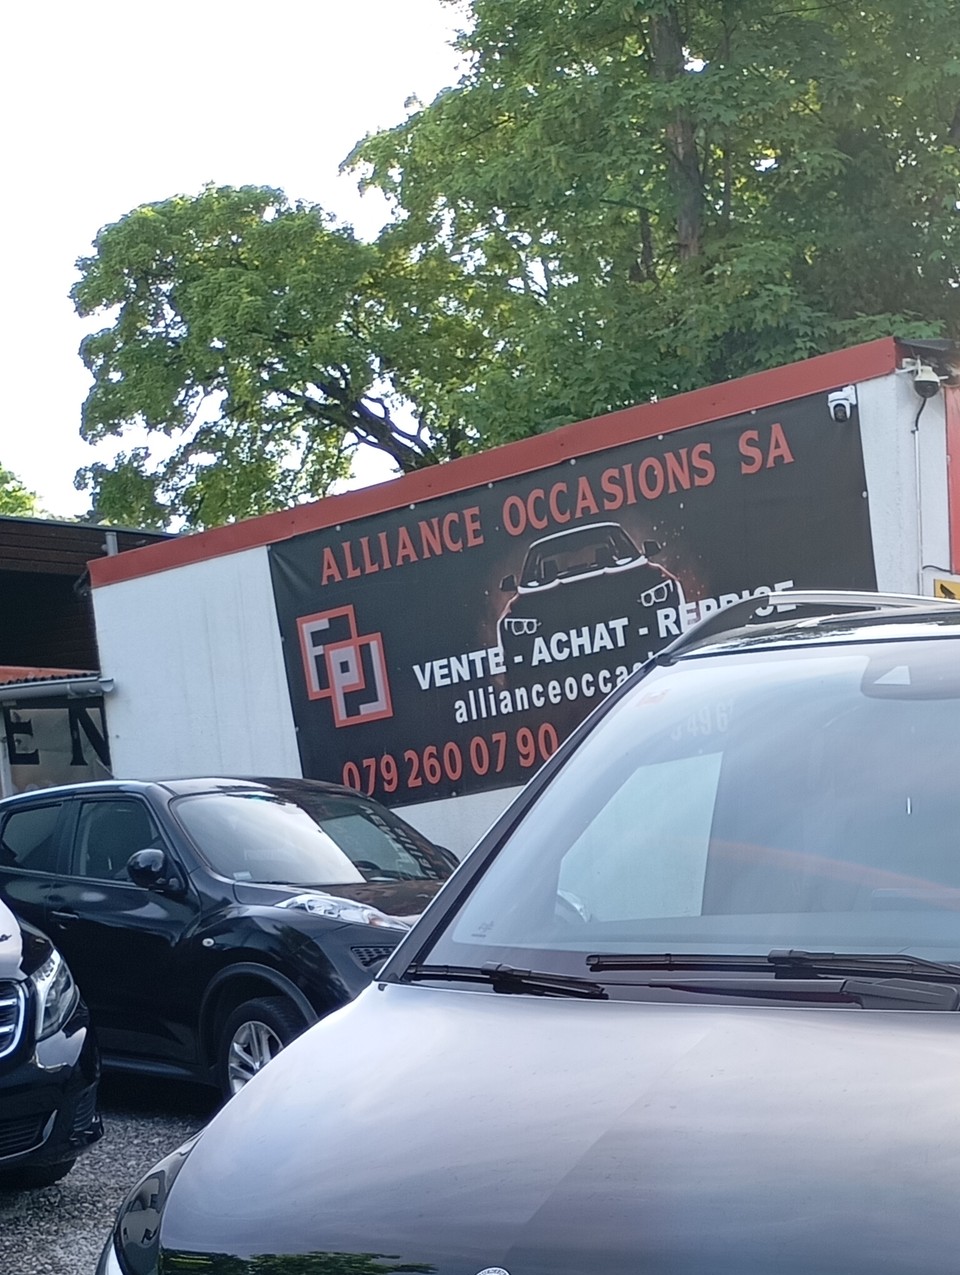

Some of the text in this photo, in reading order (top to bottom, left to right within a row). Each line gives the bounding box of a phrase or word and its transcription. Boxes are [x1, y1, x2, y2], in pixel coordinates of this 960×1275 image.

[320, 423, 795, 586] ALLIANCE OCCASIONS SA
[413, 646, 507, 690] VENTE
[531, 617, 628, 667] ACHAT
[342, 754, 398, 796] 079
[404, 741, 463, 788] 260
[469, 731, 507, 775] 07
[515, 722, 559, 767] 90
